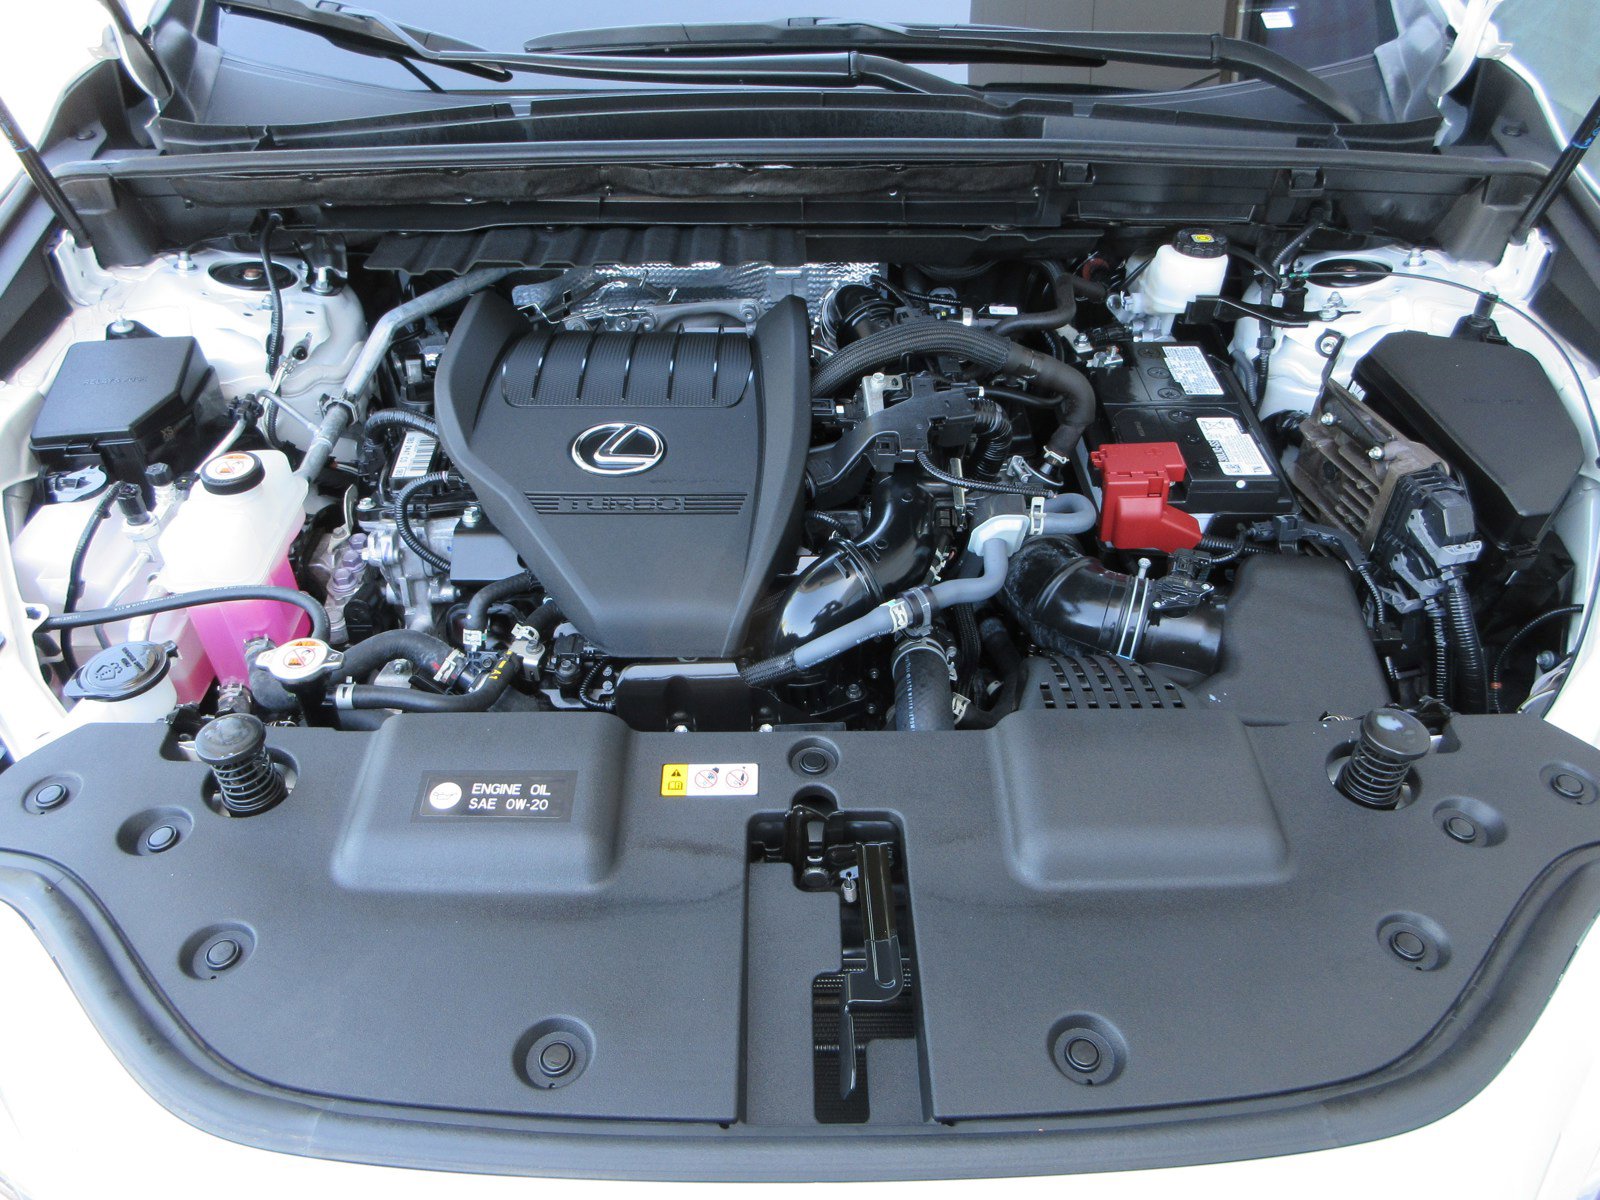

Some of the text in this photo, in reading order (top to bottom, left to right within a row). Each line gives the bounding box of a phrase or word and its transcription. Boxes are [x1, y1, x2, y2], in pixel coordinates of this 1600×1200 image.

[563, 496, 682, 511] TURBO
[471, 783, 551, 796] ENGINE OIL
[468, 798, 549, 811] SAE 0W-20
